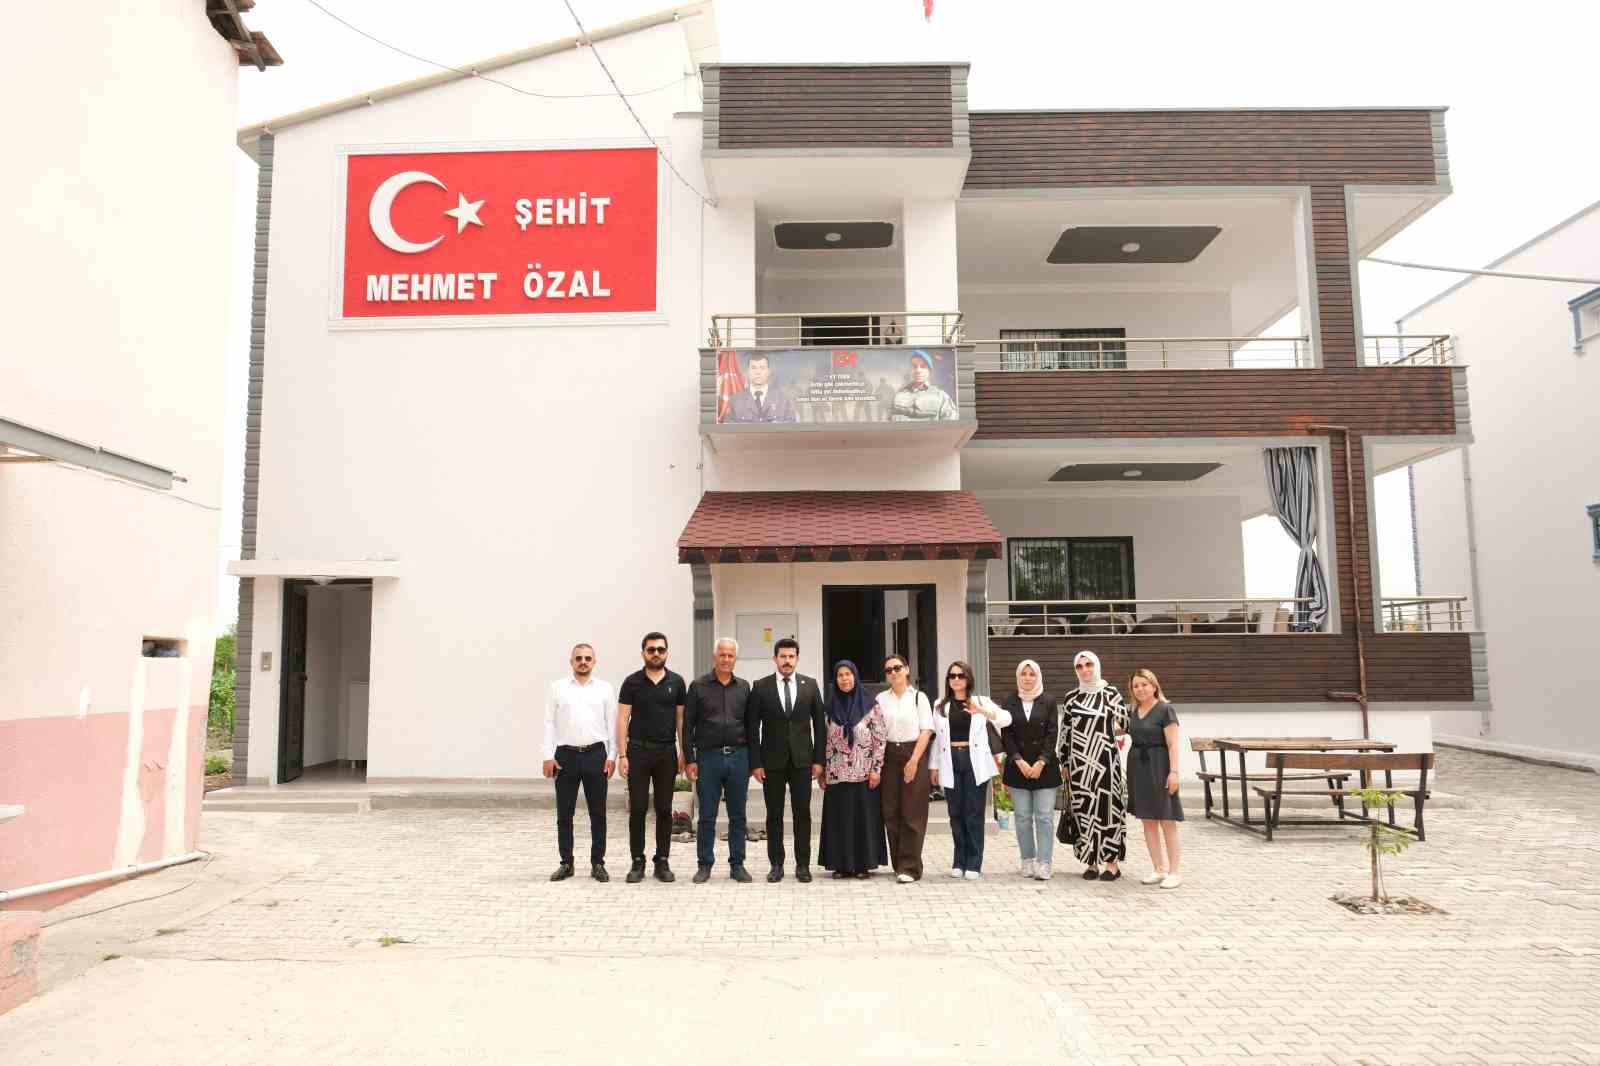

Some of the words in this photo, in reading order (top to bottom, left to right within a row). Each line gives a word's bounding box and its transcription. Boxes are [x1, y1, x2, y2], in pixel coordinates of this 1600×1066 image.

[515, 192, 611, 231] ŞEHİT
[366, 272, 498, 302] MEHMET
[523, 263, 611, 298] ÖZAL
